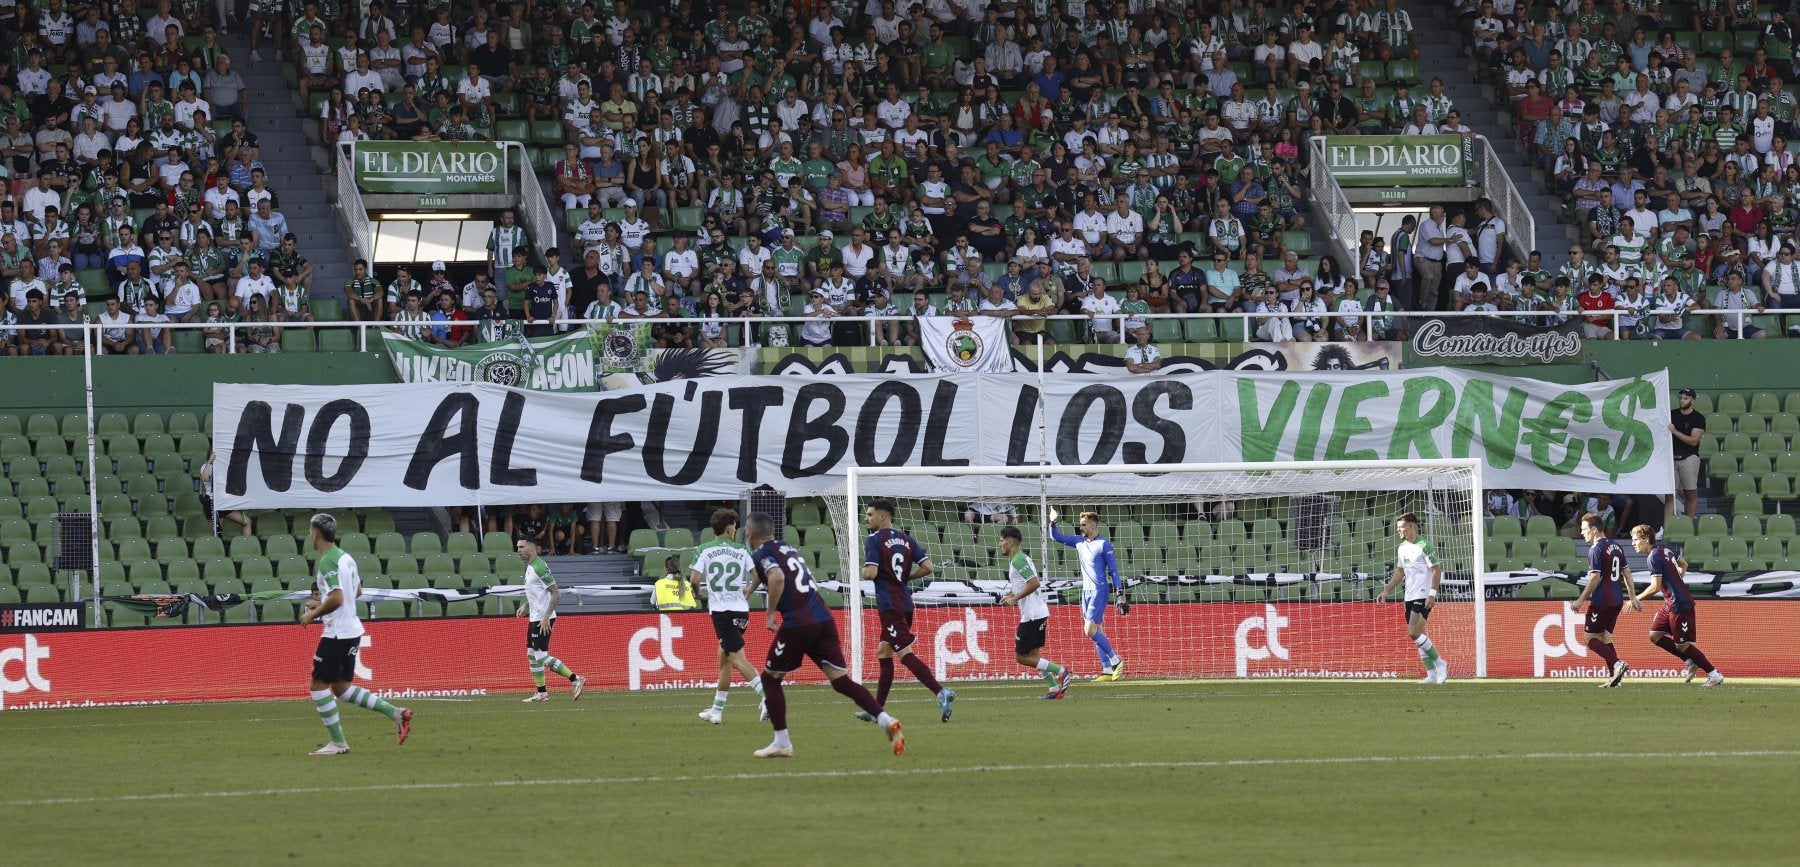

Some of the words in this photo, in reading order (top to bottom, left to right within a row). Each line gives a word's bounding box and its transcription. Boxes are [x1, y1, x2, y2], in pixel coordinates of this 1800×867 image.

[362, 151, 398, 173] EL
[401, 151, 498, 174] DIARIO
[1331, 146, 1365, 167] EL
[1368, 144, 1461, 167] DIARIO
[446, 173, 496, 183] MONTAÑÉS
[1411, 166, 1459, 175] MONTAÑÉS
[420, 198, 446, 206] SALIDA
[1381, 191, 1406, 199] SALIDA
[1413, 319, 1529, 357] Comando
[532, 344, 594, 391] ASÓN
[225, 399, 371, 496] NO
[403, 391, 538, 491] AL
[580, 378, 970, 486] FÚTBOL
[1005, 380, 1194, 479] LOS
[707, 547, 744, 560] RODRÍGUEZ
[708, 561, 742, 593] 22
[891, 552, 905, 582] 6
[1610, 556, 1620, 582] 9
[1, 608, 79, 627] #FANCAM
